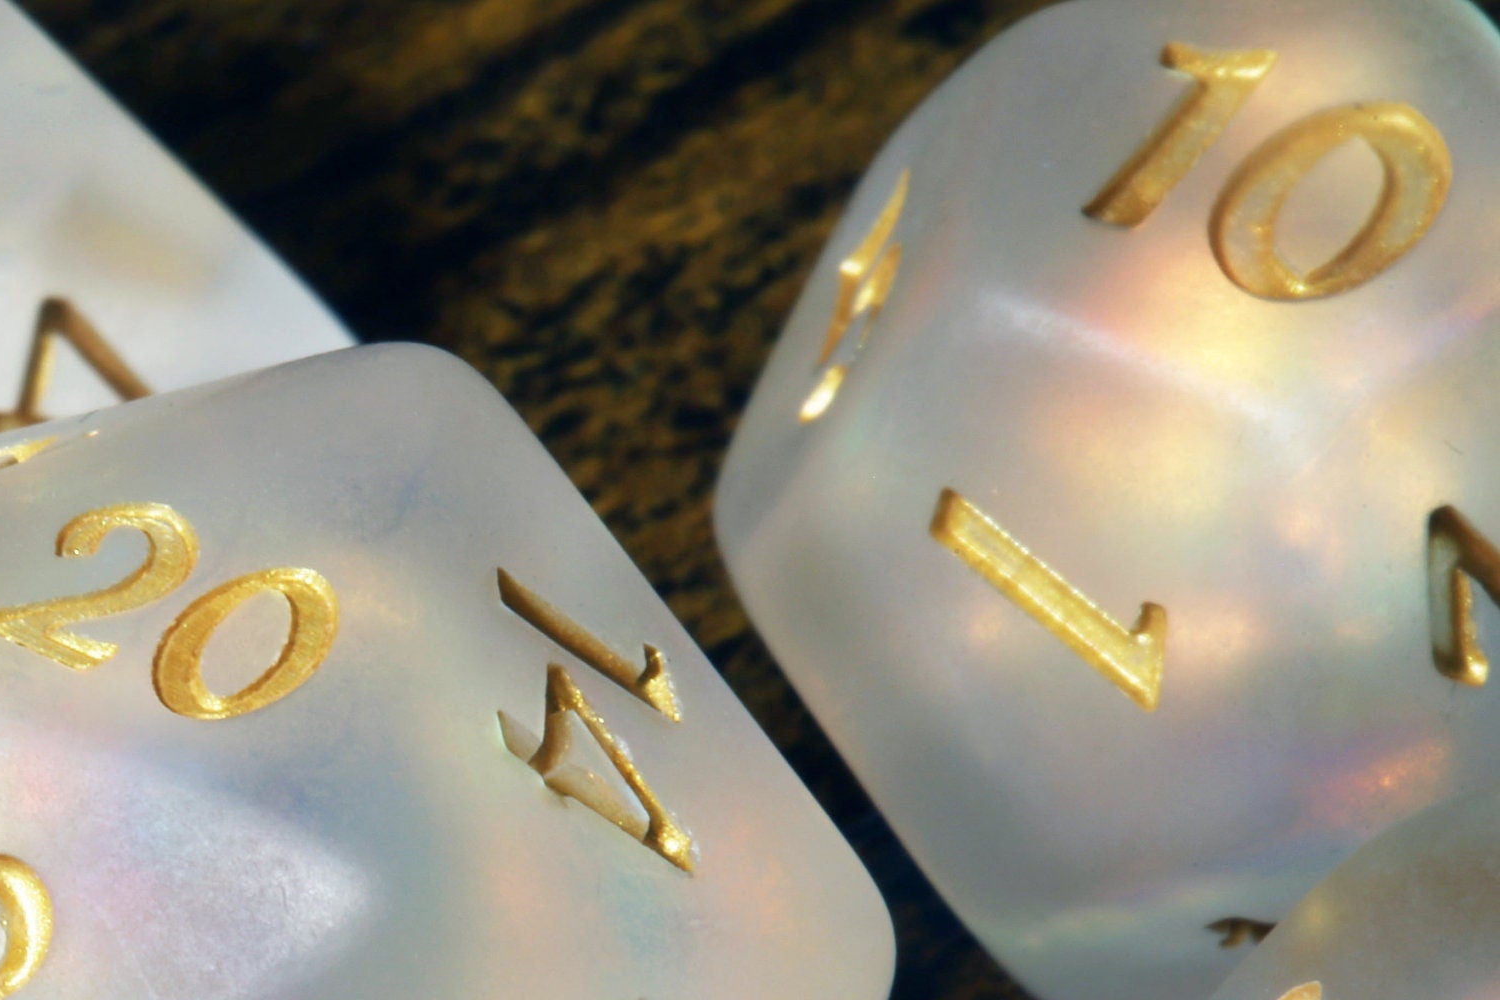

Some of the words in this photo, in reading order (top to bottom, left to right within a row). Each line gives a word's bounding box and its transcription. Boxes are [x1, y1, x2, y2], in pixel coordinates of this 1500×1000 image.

[1080, 42, 1452, 301] 10
[496, 565, 694, 875] 14
[930, 487, 1168, 712] 1
